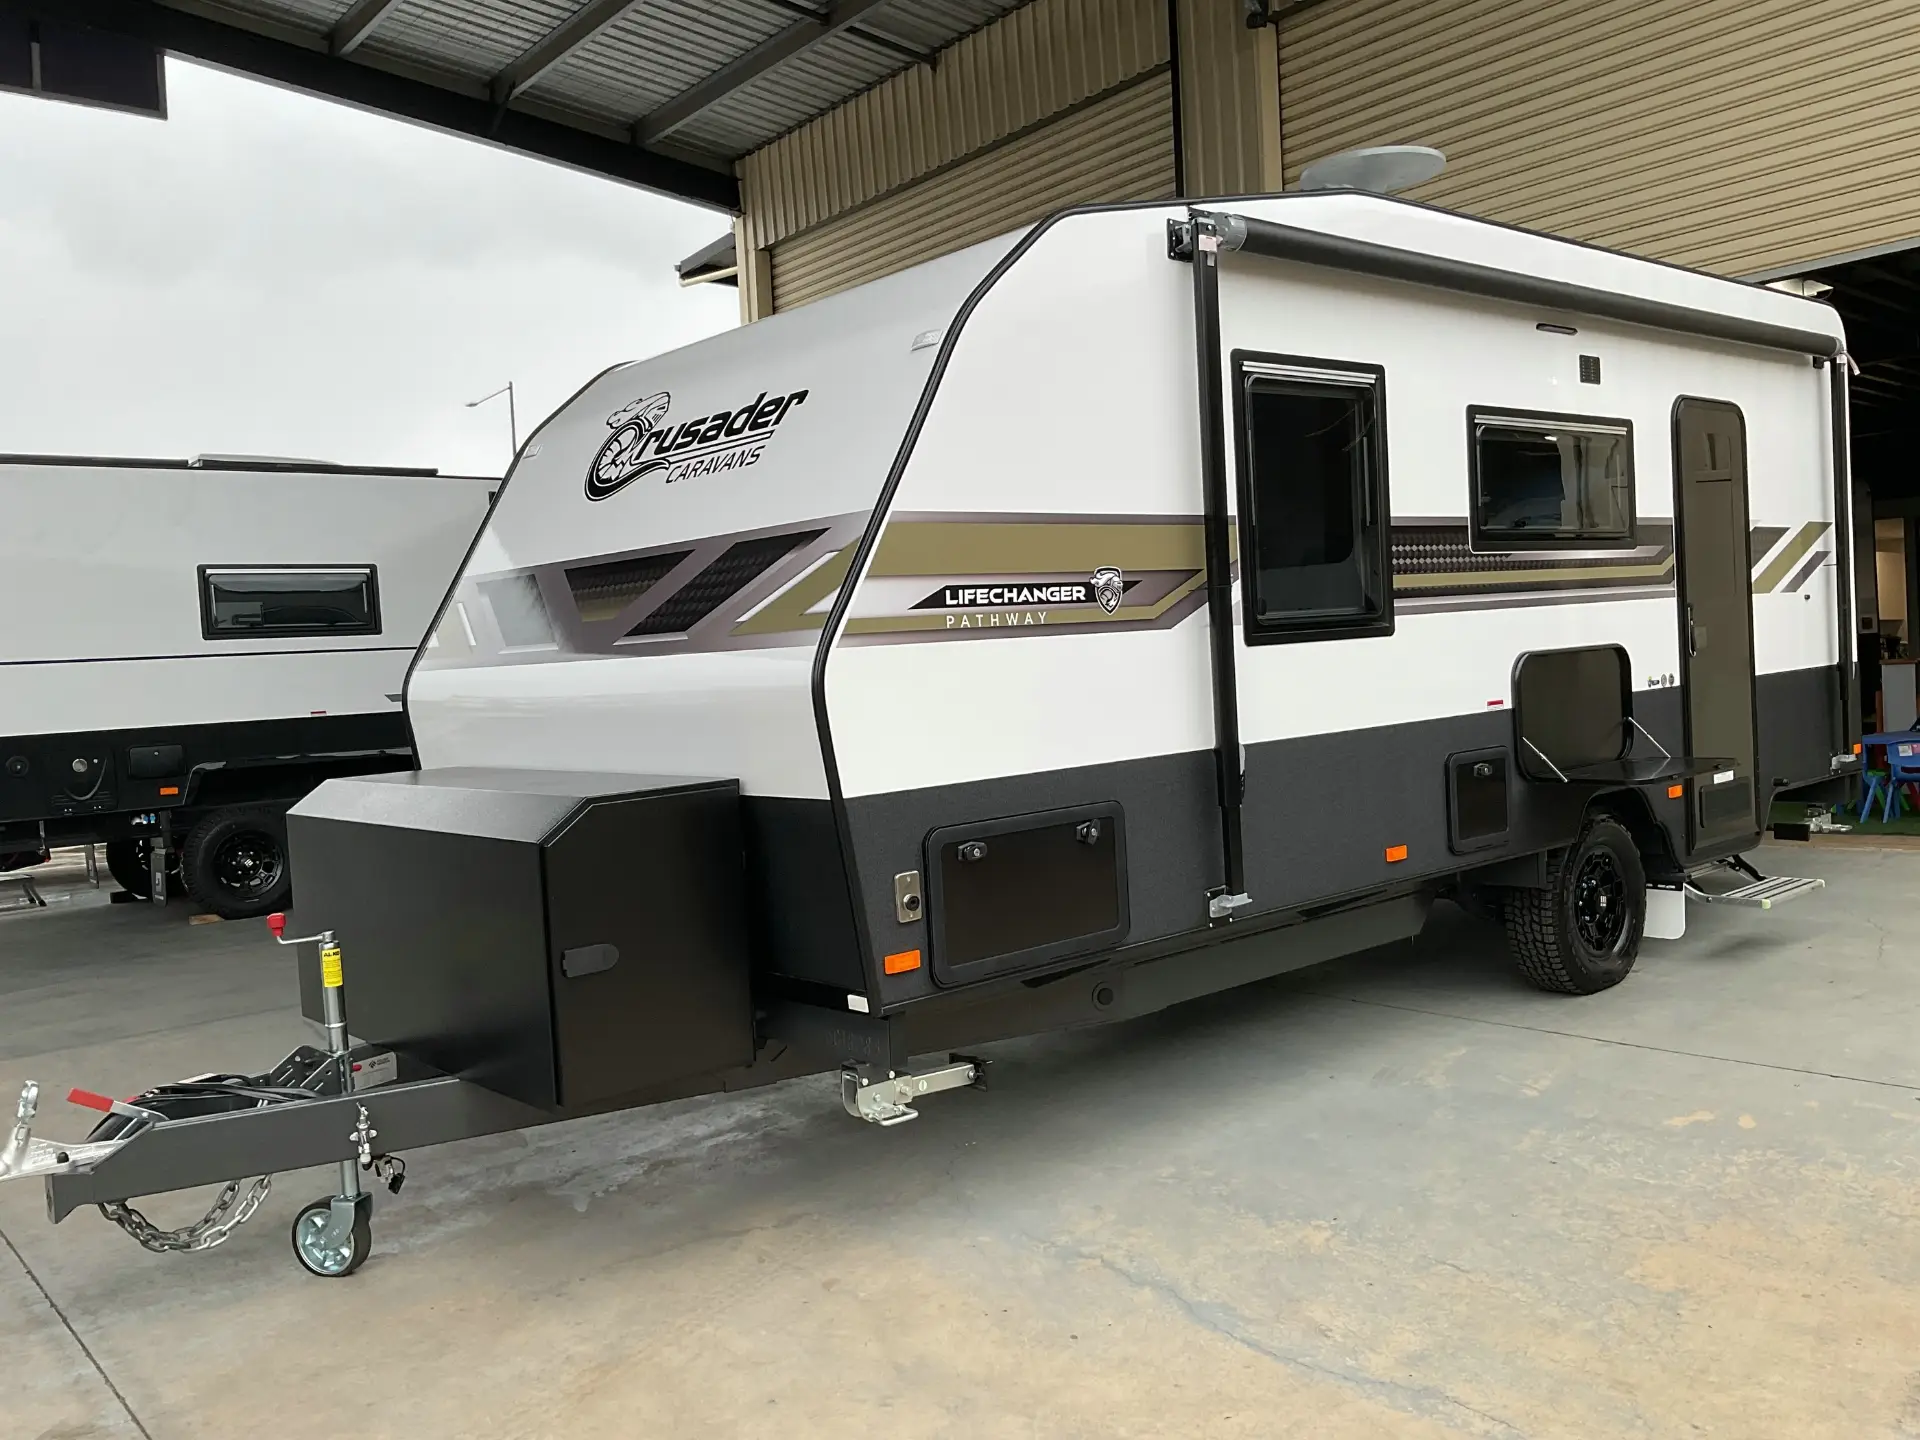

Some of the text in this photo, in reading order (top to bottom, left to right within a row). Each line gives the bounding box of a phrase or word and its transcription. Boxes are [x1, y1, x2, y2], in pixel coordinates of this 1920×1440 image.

[665, 445, 765, 484] CARAVANS
[945, 586, 1086, 605] LIFECHANGER
[946, 611, 1047, 629] PATHWAY
